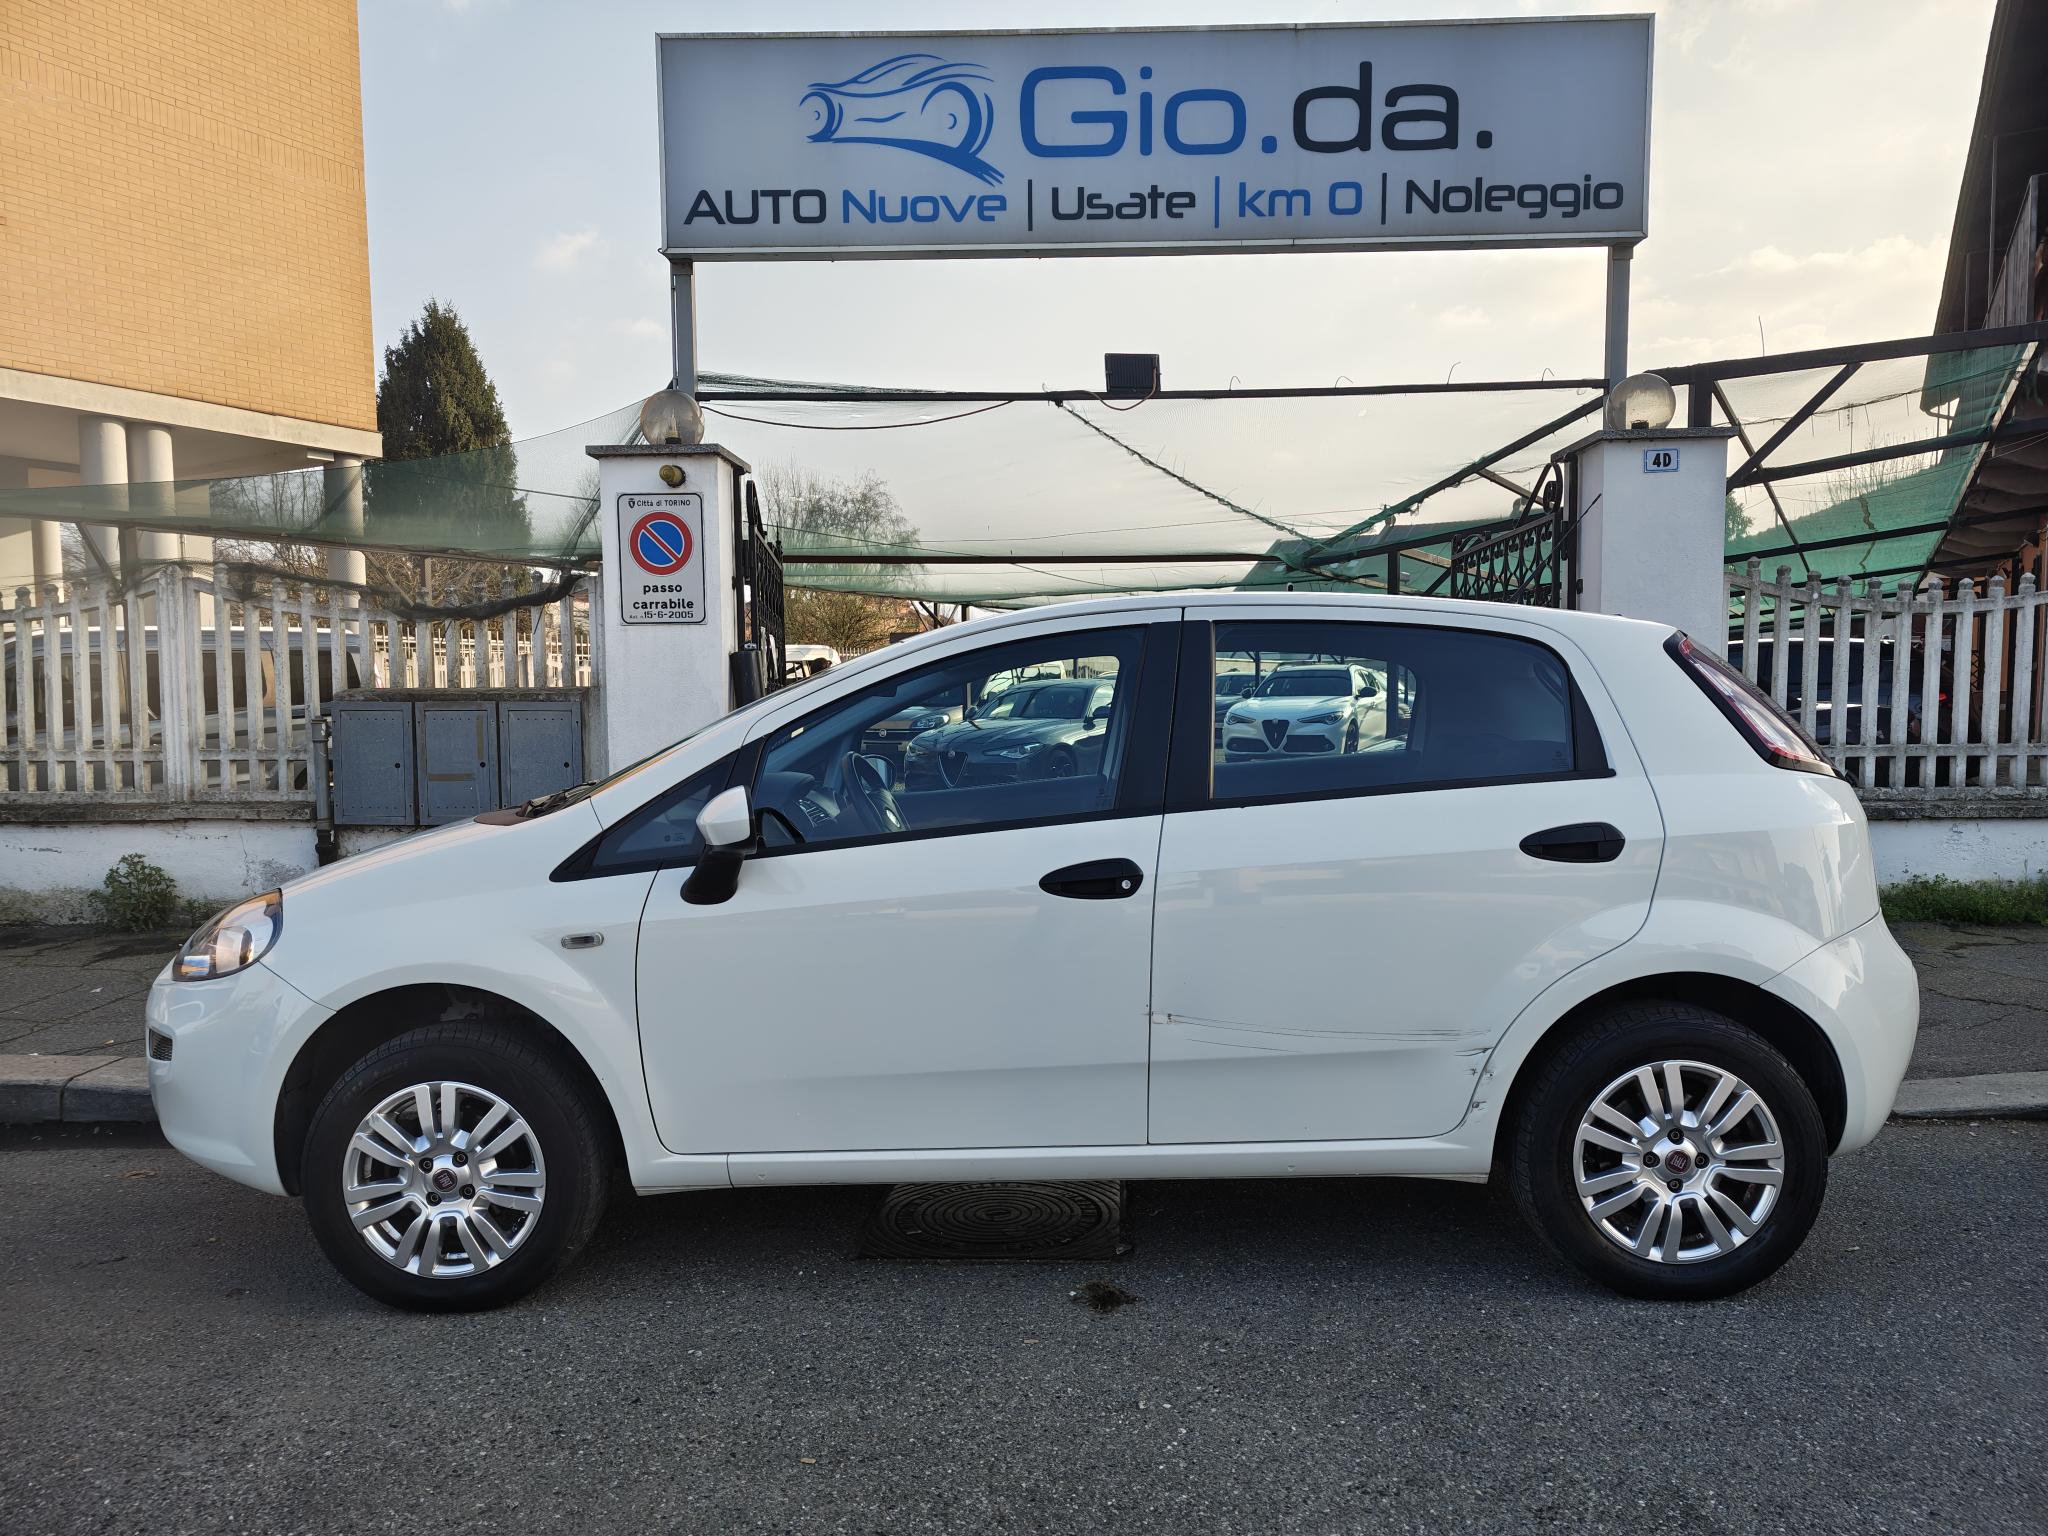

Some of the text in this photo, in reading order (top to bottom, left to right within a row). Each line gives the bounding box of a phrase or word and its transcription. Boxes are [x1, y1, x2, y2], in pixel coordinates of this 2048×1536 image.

[1020, 61, 1493, 158] Gio.da.
[684, 189, 827, 225] AUTO
[842, 189, 1008, 225] Nuove
[1052, 183, 1196, 221] Usate
[1238, 180, 1311, 217] km
[1405, 174, 1624, 220] Noleggio
[1652, 453, 1672, 467] 4D
[636, 499, 691, 507] Città di TORINO
[643, 584, 683, 595] passo
[632, 598, 694, 610] carrabile
[643, 610, 694, 619] 15-6-2005
